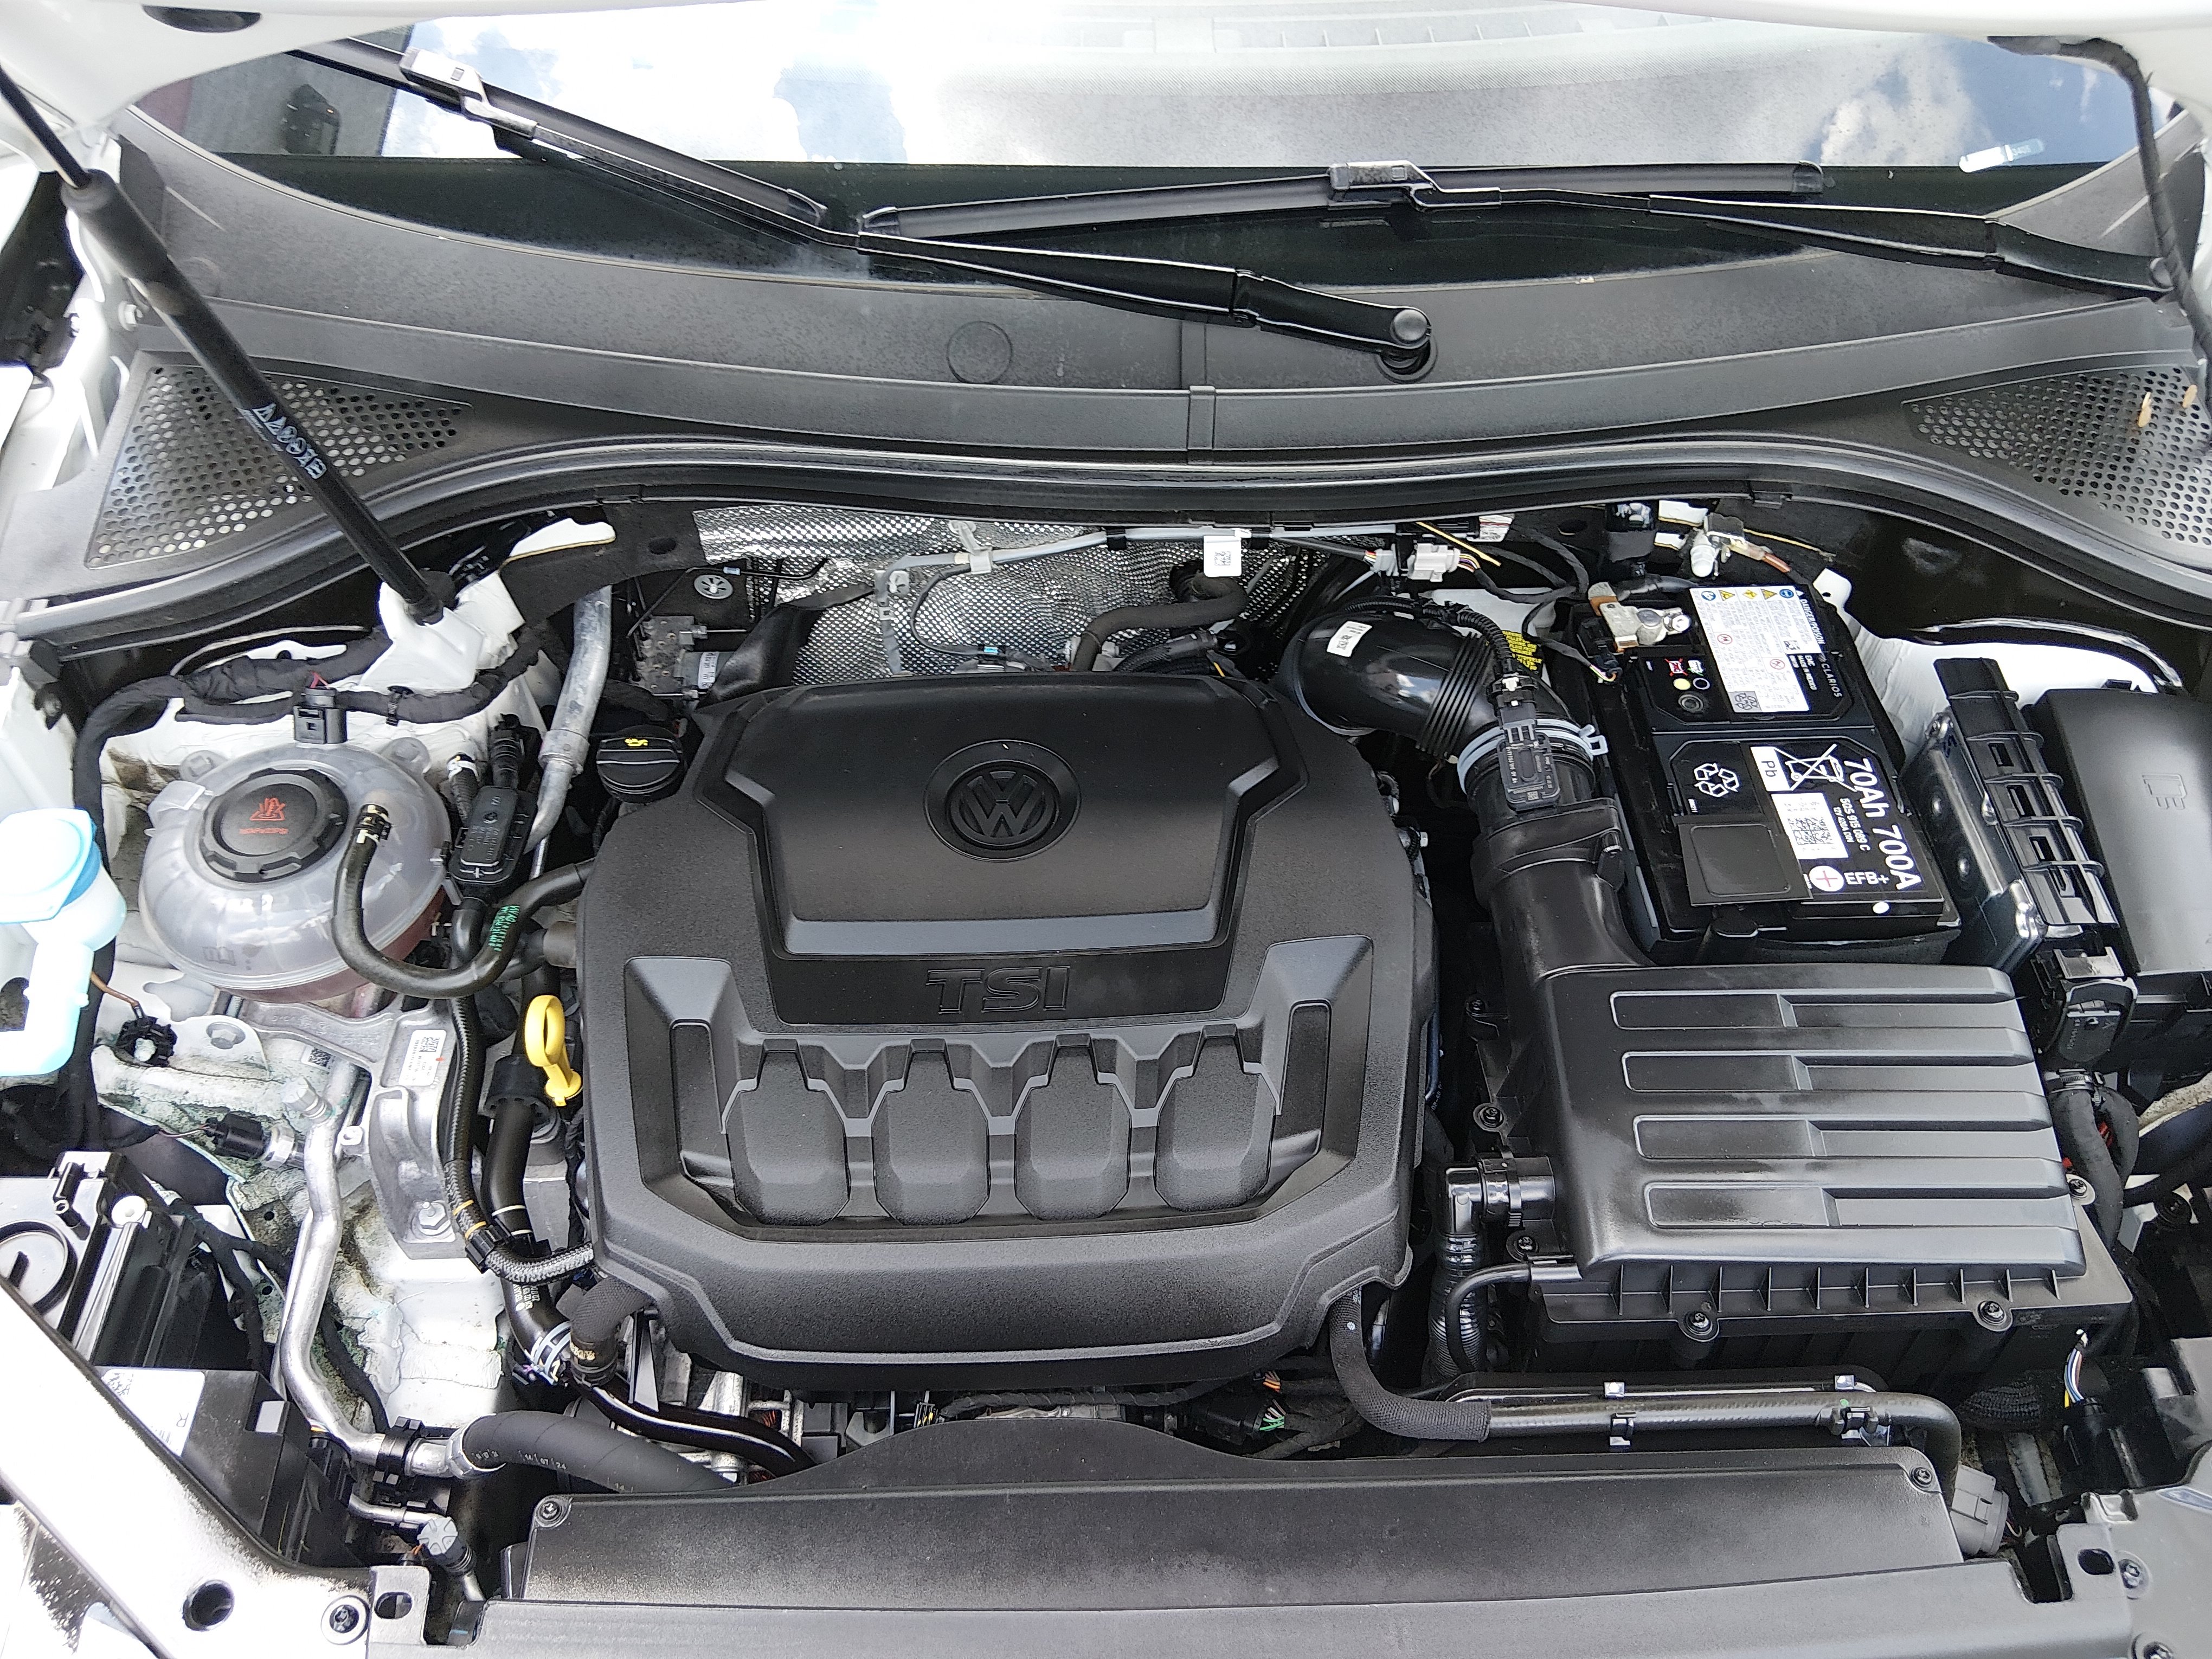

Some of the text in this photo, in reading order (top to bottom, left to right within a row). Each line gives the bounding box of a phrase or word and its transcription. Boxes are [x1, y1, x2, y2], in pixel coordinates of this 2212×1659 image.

[1821, 663, 1843, 698] CLARIOS
[1761, 761, 1778, 777] Pb
[1843, 758, 1922, 890] 70Ah 700A
[1847, 815, 1861, 828] 915
[1843, 871, 1890, 885] EFB+
[926, 966, 1071, 1015] TSI
[176, 1412, 189, 1427] R
